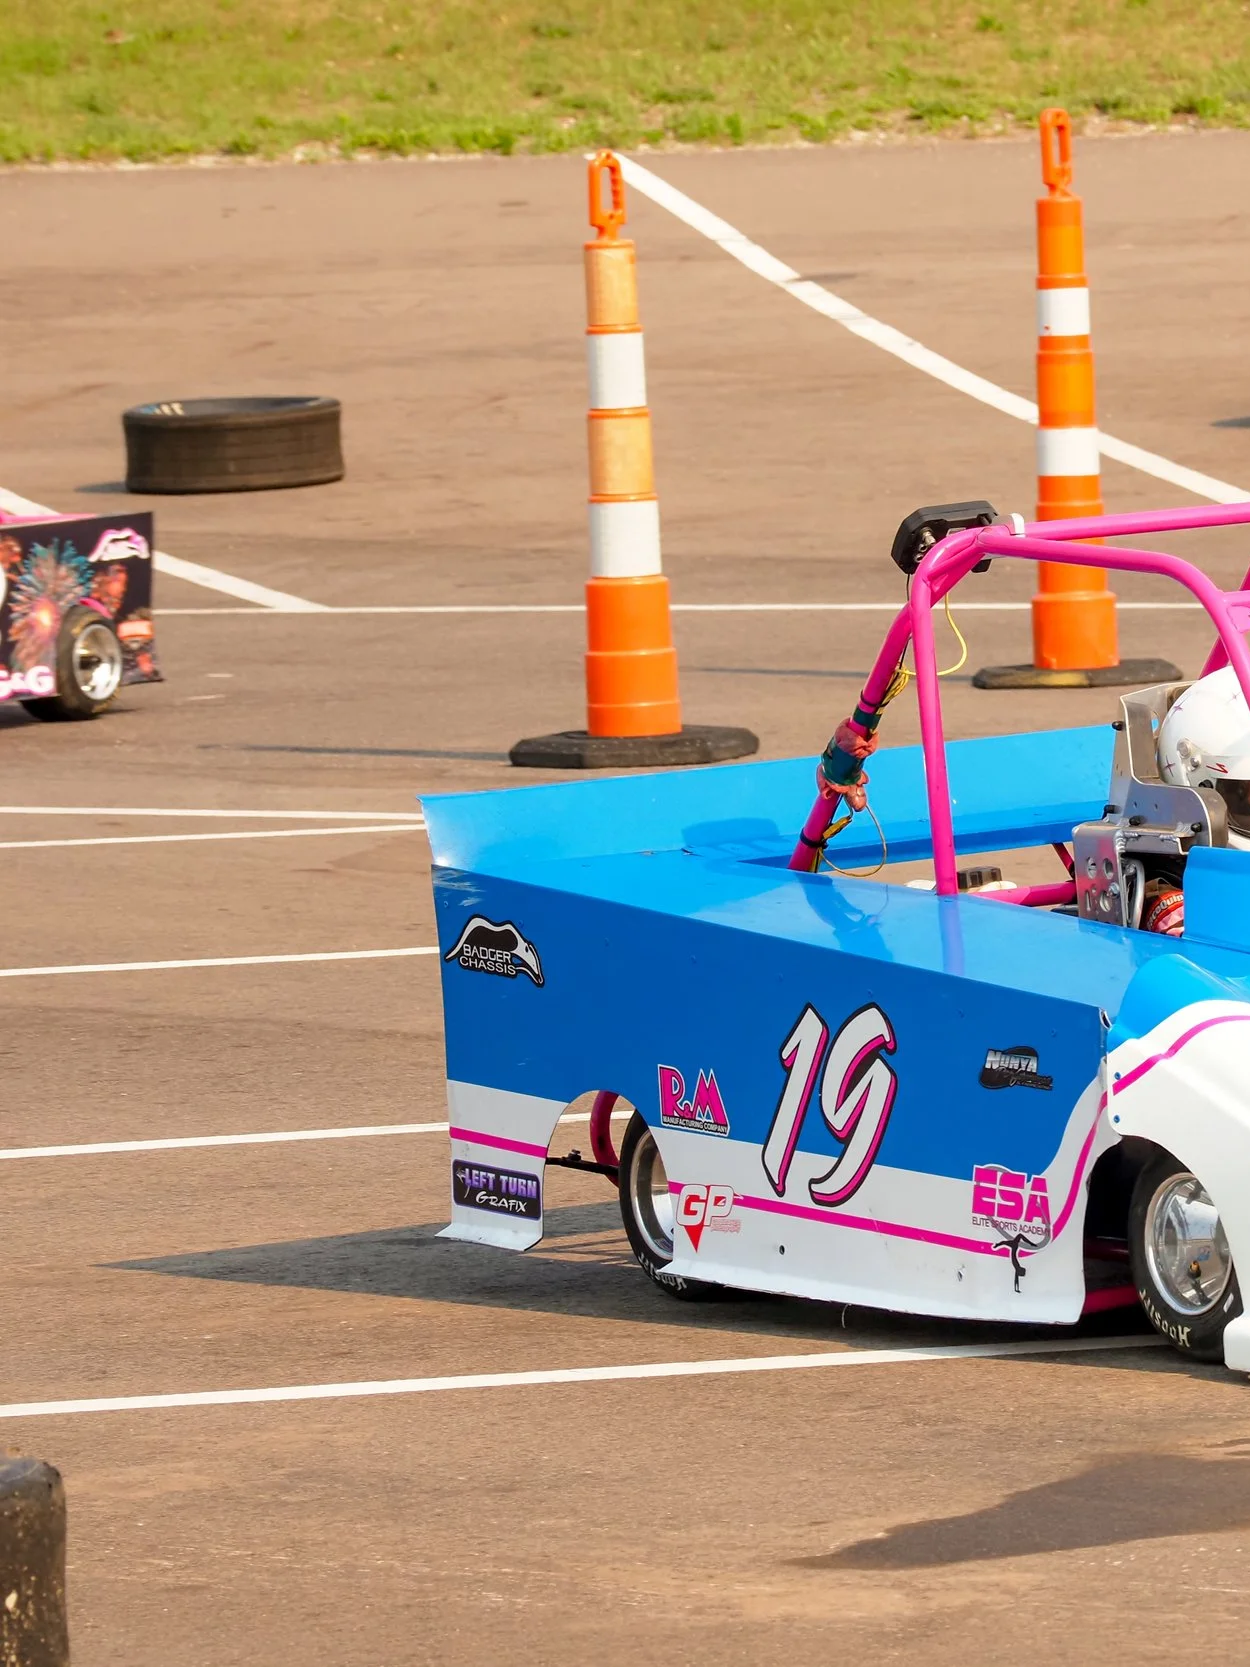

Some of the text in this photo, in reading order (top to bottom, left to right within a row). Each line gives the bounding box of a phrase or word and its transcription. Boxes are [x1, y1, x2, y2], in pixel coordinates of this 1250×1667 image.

[463, 943, 512, 964] BADGER
[460, 956, 516, 975] CHASSIS
[761, 1002, 897, 1207] 19
[703, 1123, 728, 1134] COMPANY
[464, 1168, 537, 1199] LEFT TURN
[475, 1191, 527, 1213] GRAFIX
[676, 1184, 734, 1227] GP
[971, 1167, 1050, 1225] ESA
[972, 1217, 990, 1227] ELITE
[991, 1220, 1018, 1232] SPORTS
